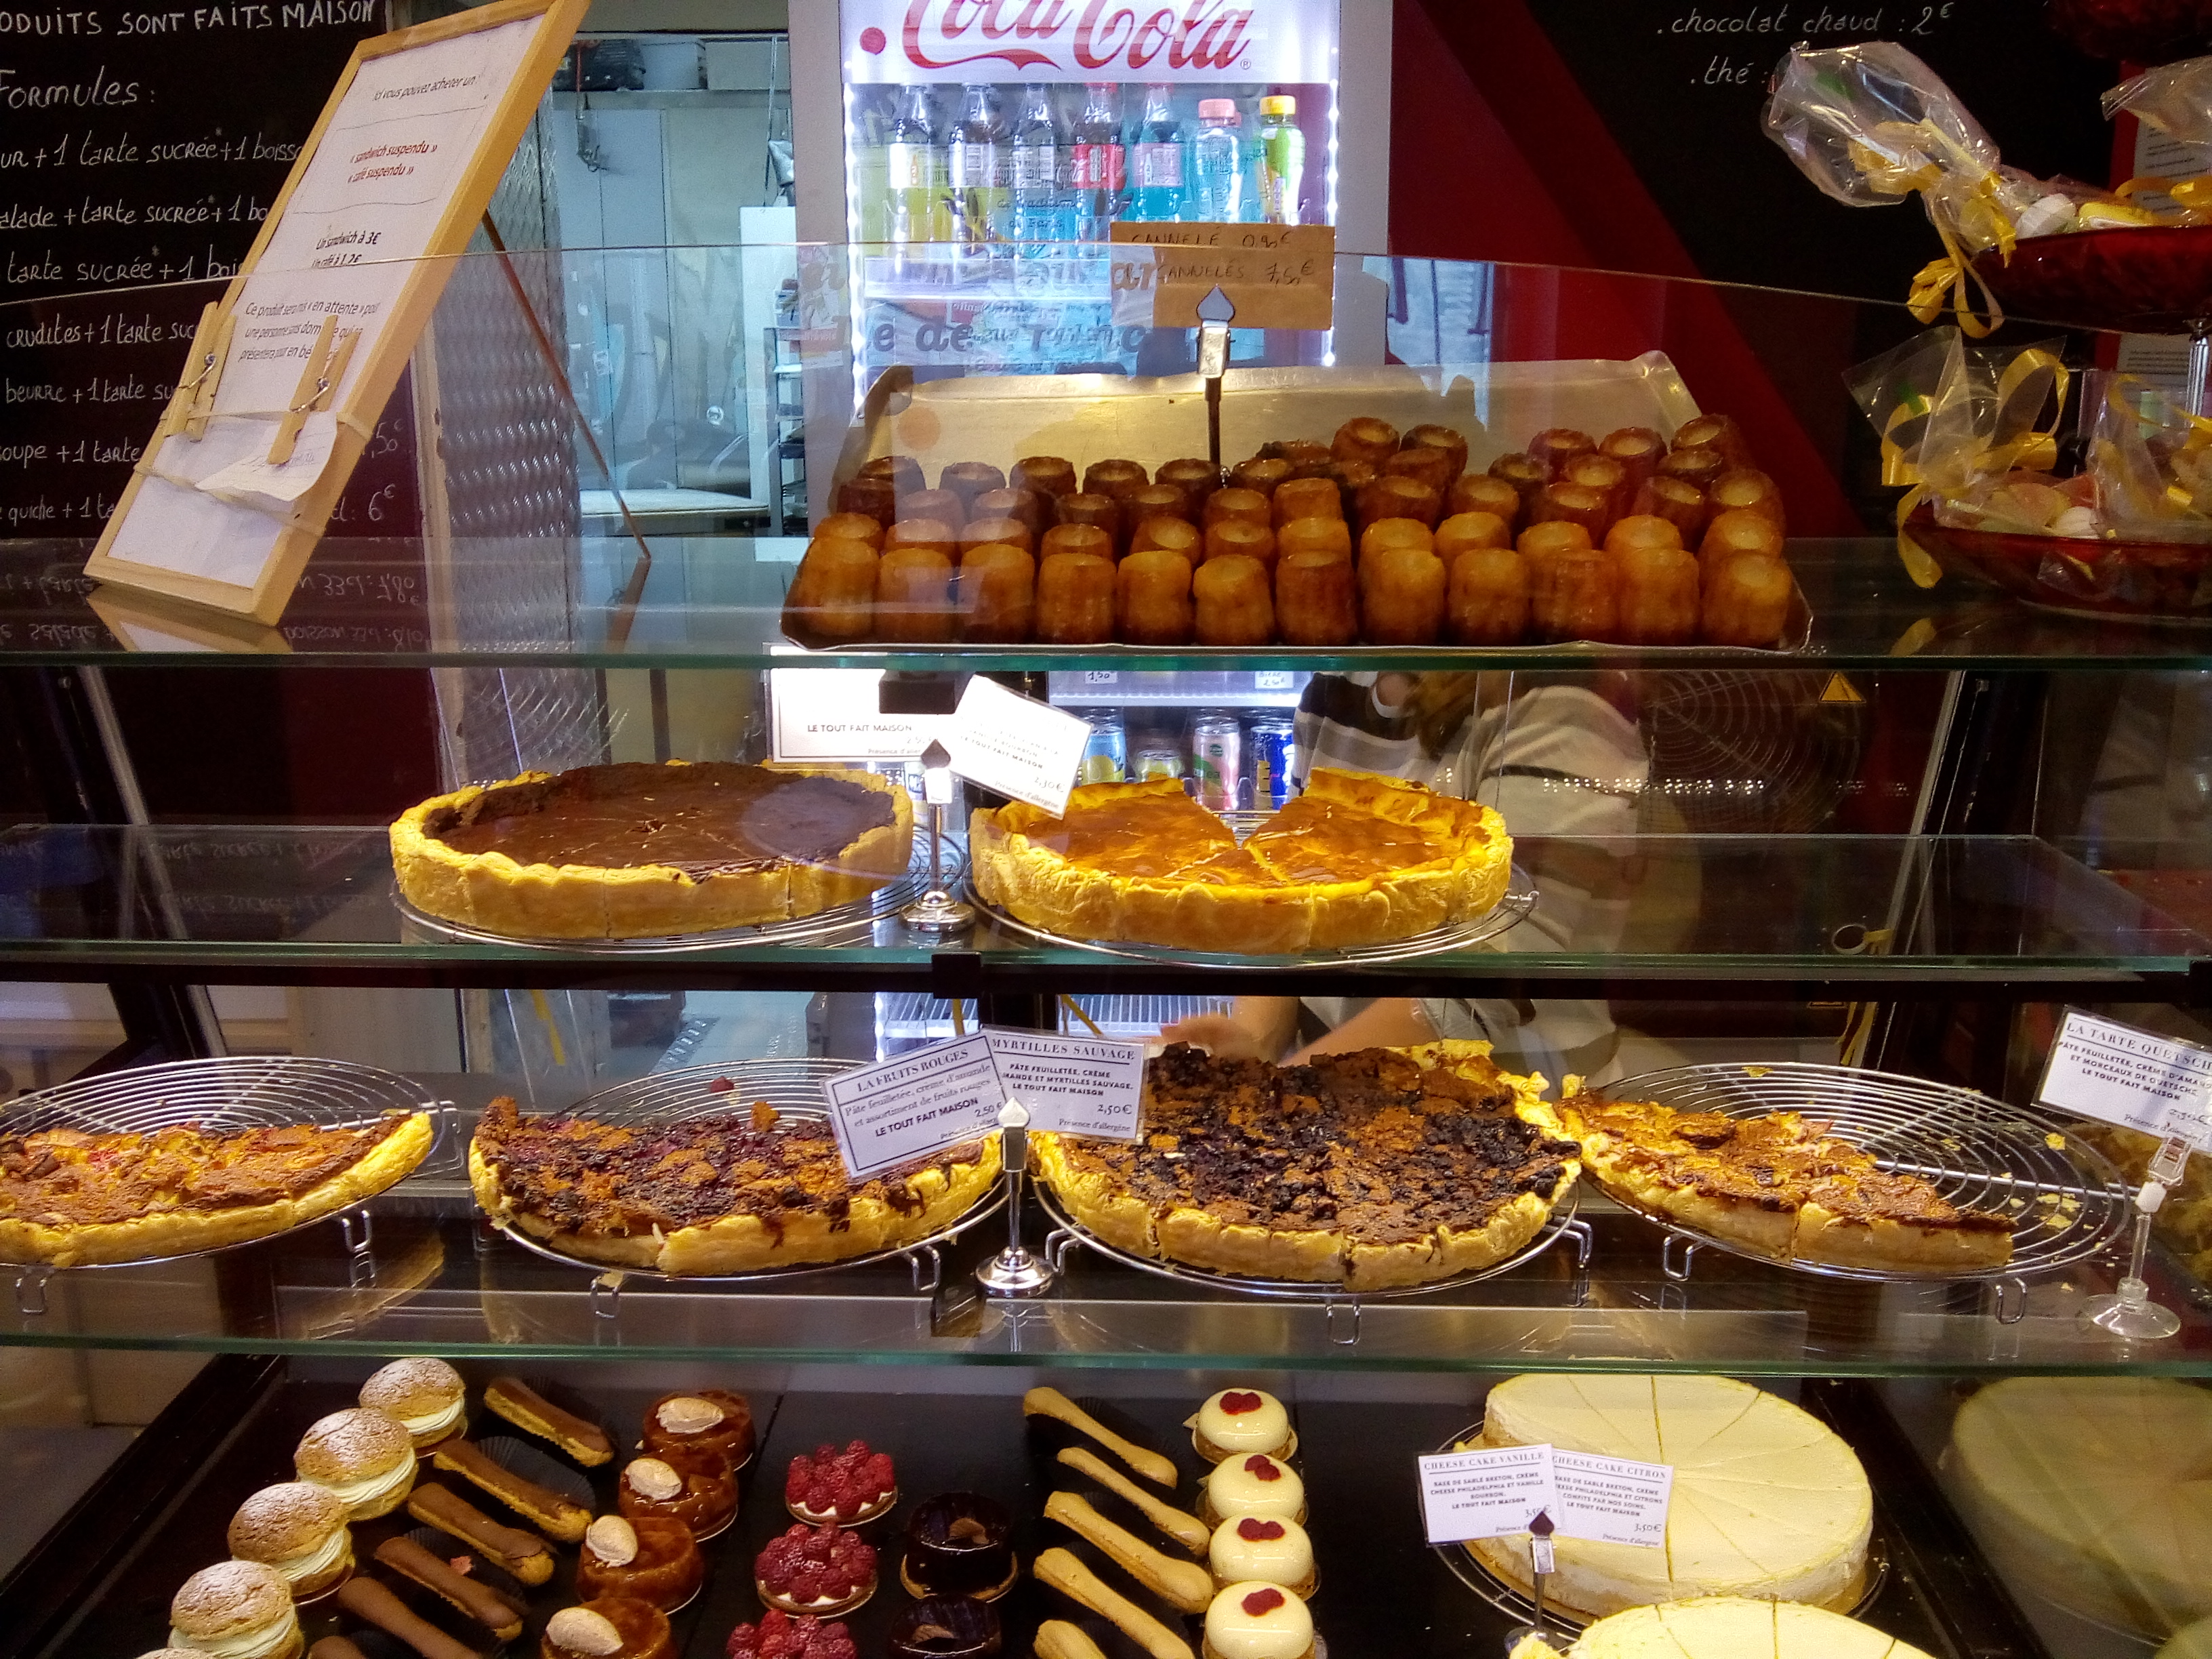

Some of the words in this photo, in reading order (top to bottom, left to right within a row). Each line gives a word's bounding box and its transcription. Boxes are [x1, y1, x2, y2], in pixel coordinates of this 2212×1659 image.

[117, 13, 184, 36] SONT
[282, 0, 374, 28] MAISON
[1671, 3, 1788, 33] chocolat
[1803, 6, 1882, 33] chaud
[1704, 56, 1754, 85] thé
[386, 140, 430, 159] suspendu
[365, 163, 406, 181] suspendu
[245, 302, 257, 315] Ce
[324, 300, 359, 315] attente
[807, 724, 818, 733] LE
[820, 724, 846, 733] TOUT
[850, 724, 870, 733] FAIT
[873, 724, 913, 733] MAISON
[972, 739, 991, 750] TOUT
[993, 747, 1010, 757] FAIT
[1012, 754, 1044, 770] MAISON
[2067, 1022, 2084, 1035] LA
[2090, 1029, 2137, 1050] TARTE
[992, 1038, 1068, 1054] MYRTILLES
[1073, 1044, 1136, 1060] SAUVAGE
[857, 1080, 874, 1092] LA
[876, 1065, 919, 1086] FRUITS
[920, 1048, 969, 1071] ROUGES
[1009, 1063, 1029, 1071] PÂTE
[1082, 1068, 1111, 1078] CRÈME
[2083, 1058, 2133, 1077] MORCEAUX
[2135, 1073, 2147, 1081] DE
[2135, 1063, 2167, 1078] CRÈME
[844, 1105, 866, 1117] Pâte
[916, 1079, 945, 1094] crème
[946, 1063, 991, 1084] d'amande
[1023, 1084, 1046, 1092] TOUT
[1069, 1087, 1105, 1097] MAISON
[1046, 1076, 1090, 1086] MYRTILLES
[2094, 1072, 2118, 1083] TOUT
[2120, 1079, 2141, 1090] FAIT
[2142, 1085, 2182, 1101] MAISON
[854, 1120, 863, 1128] et
[865, 1101, 918, 1124] assortiment
[920, 1095, 933, 1107] de
[934, 1087, 958, 1102] fruits
[960, 1078, 991, 1094] rouges
[875, 1128, 886, 1137] LE
[889, 1118, 914, 1131] TOUT
[916, 1110, 937, 1124] FAIT
[939, 1097, 979, 1116] MAISON
[1059, 1118, 1091, 1129] Présence
[1092, 1120, 1132, 1132] d'allergène
[1424, 1460, 1465, 1471] CHEESE
[1469, 1456, 1497, 1467] CAKE
[1499, 1452, 1544, 1463] VANILLE
[1552, 1456, 1592, 1469] CHEESE
[1595, 1462, 1624, 1473] CAKE
[1627, 1468, 1666, 1479] CITRON
[1457, 1483, 1505, 1493] PHILADELPHIA
[1562, 1493, 1591, 1502] CONFITS
[1574, 1487, 1623, 1499] PHILADELPHIA
[1634, 1496, 1663, 1504] CITRONS
[1498, 1497, 1526, 1505] MAISON
[1612, 1508, 1641, 1517] MAISON
